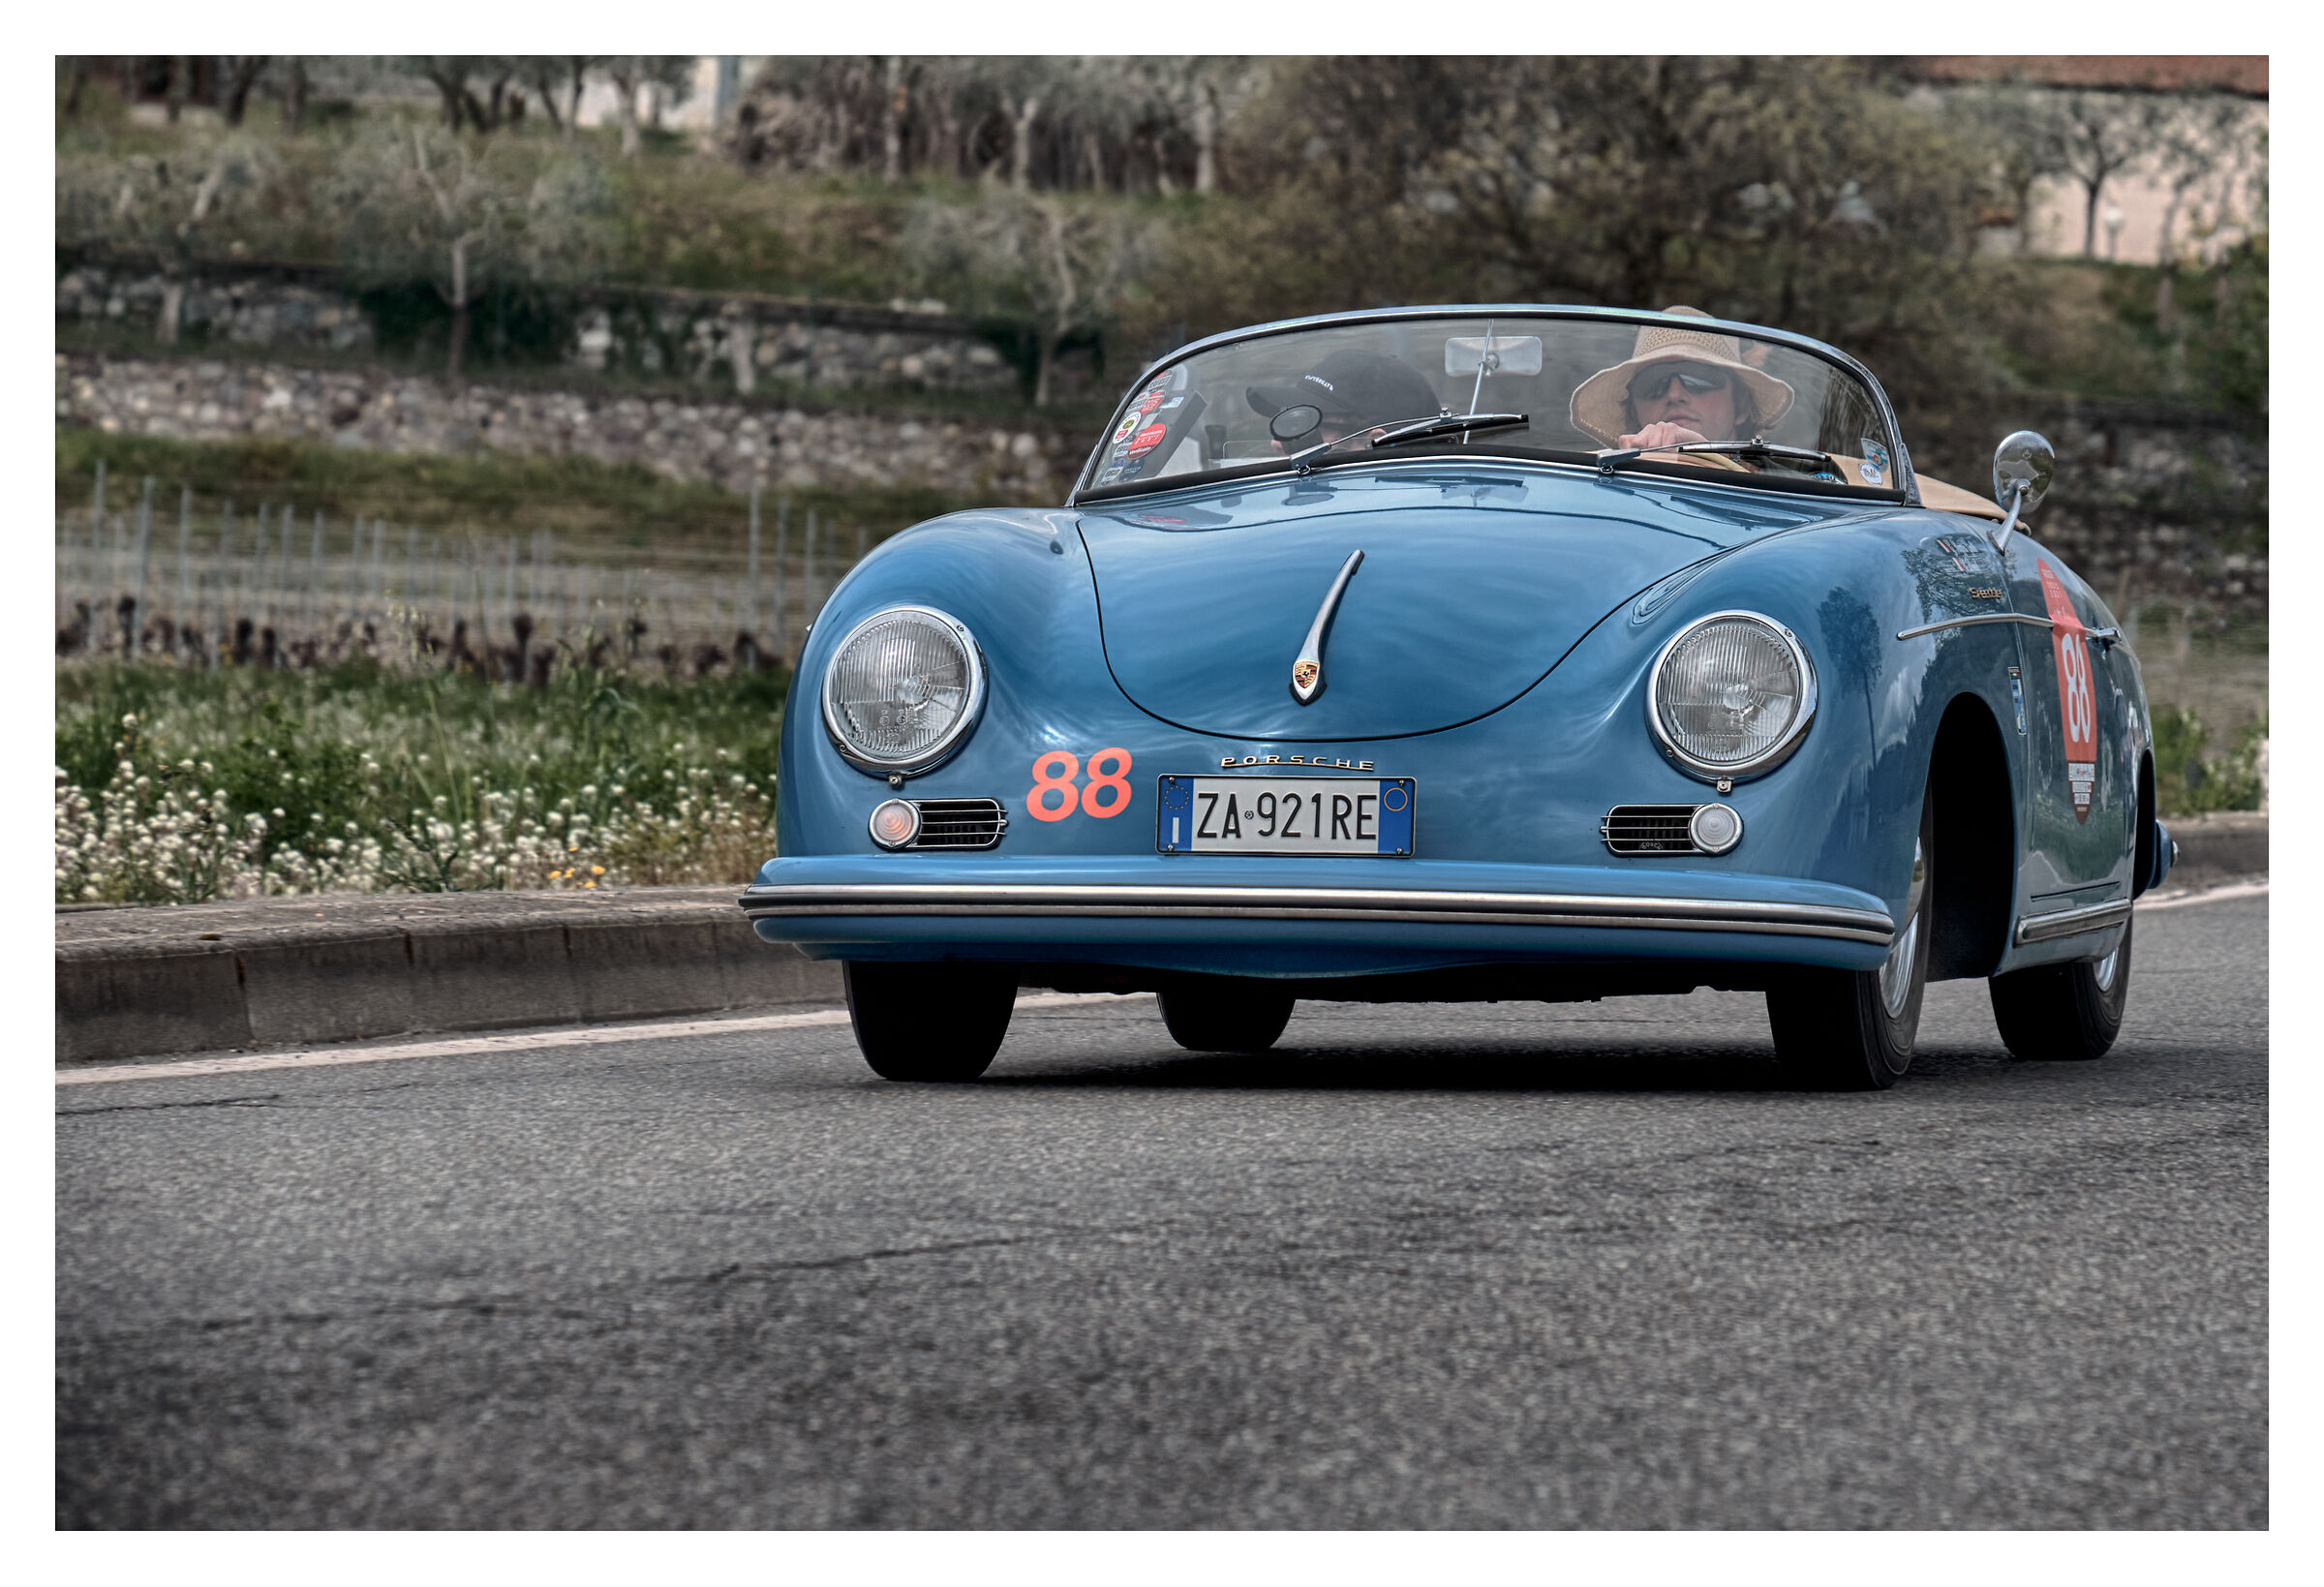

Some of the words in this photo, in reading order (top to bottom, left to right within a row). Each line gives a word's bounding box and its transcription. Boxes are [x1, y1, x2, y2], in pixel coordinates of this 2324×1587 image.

[2062, 632, 2091, 744] 88
[1026, 747, 1132, 822] 88
[1221, 754, 1374, 772] PORSCHE
[1172, 817, 1179, 843] I
